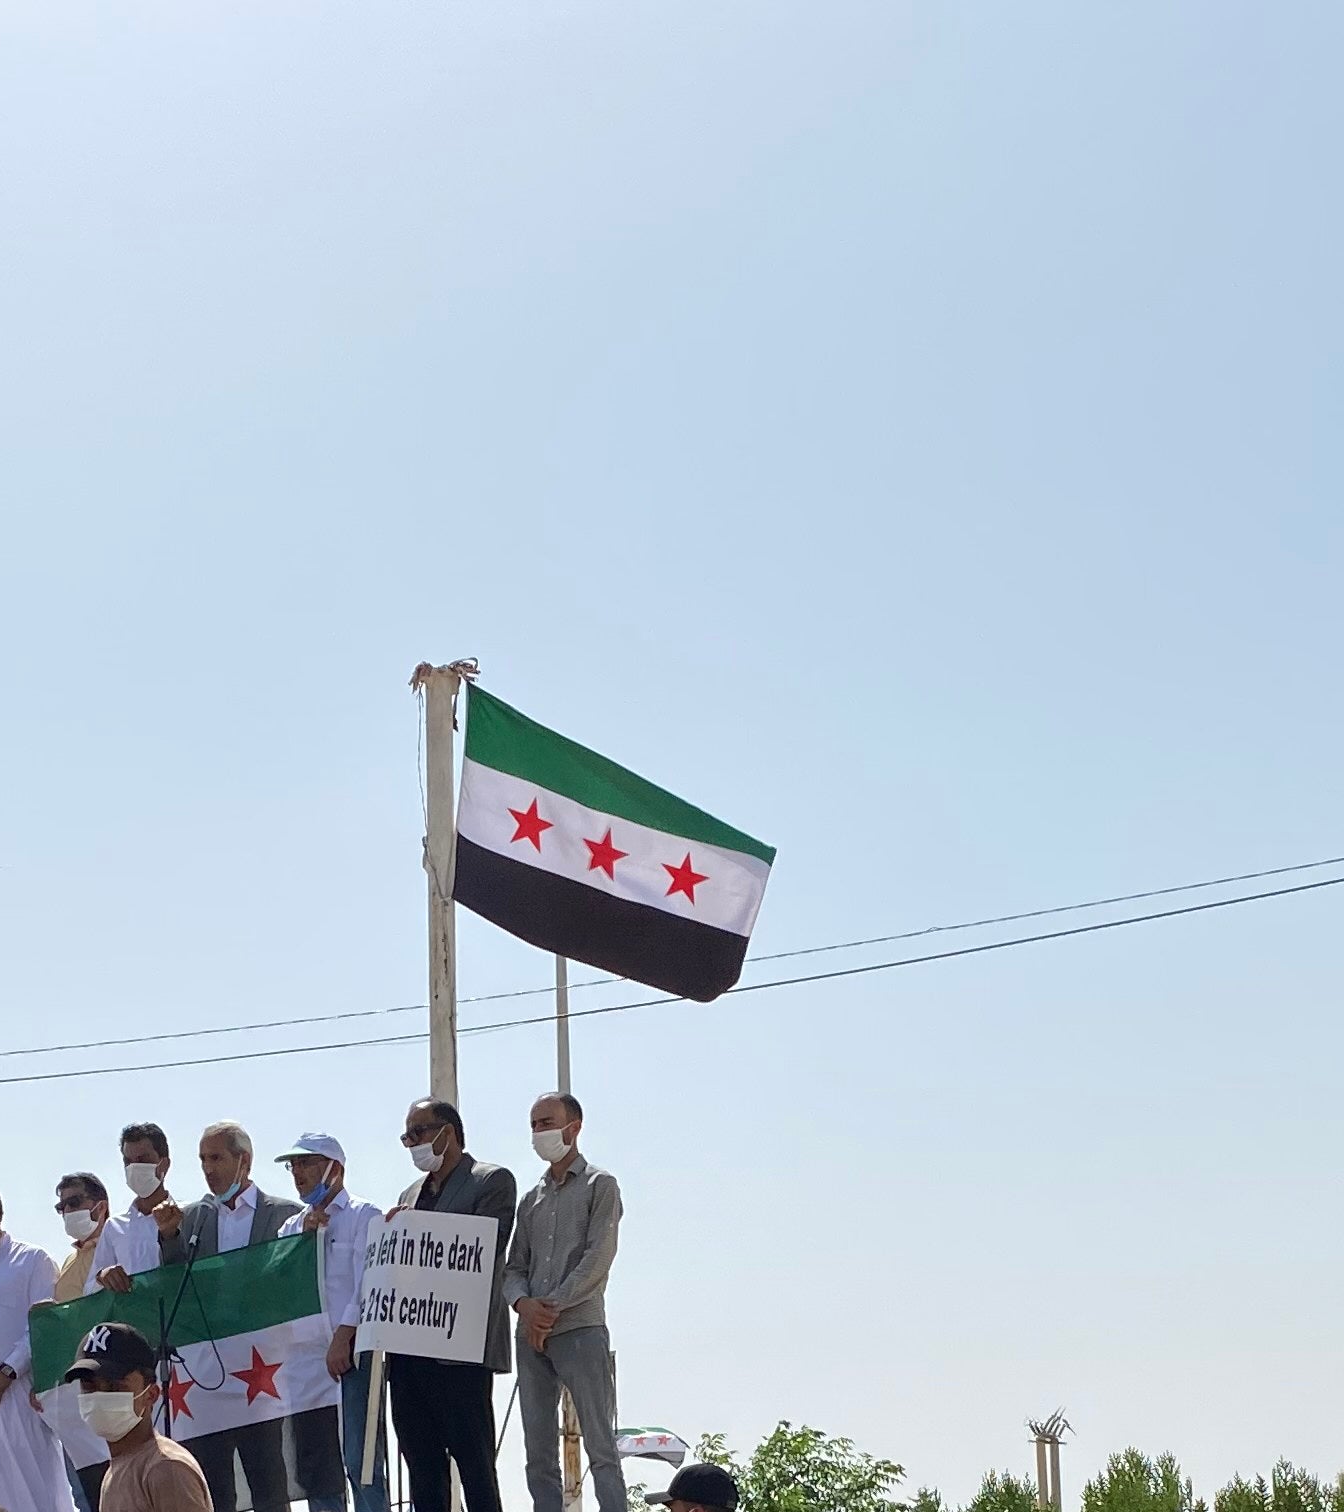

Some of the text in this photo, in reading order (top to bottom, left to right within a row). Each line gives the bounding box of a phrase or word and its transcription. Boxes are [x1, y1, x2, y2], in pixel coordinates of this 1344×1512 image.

[376, 1229, 398, 1266] left
[400, 1229, 415, 1266] in
[419, 1231, 444, 1269] the
[448, 1234, 484, 1273] dark
[366, 1287, 396, 1323] 21st
[399, 1292, 458, 1339] century
[83, 1325, 111, 1353] NY
